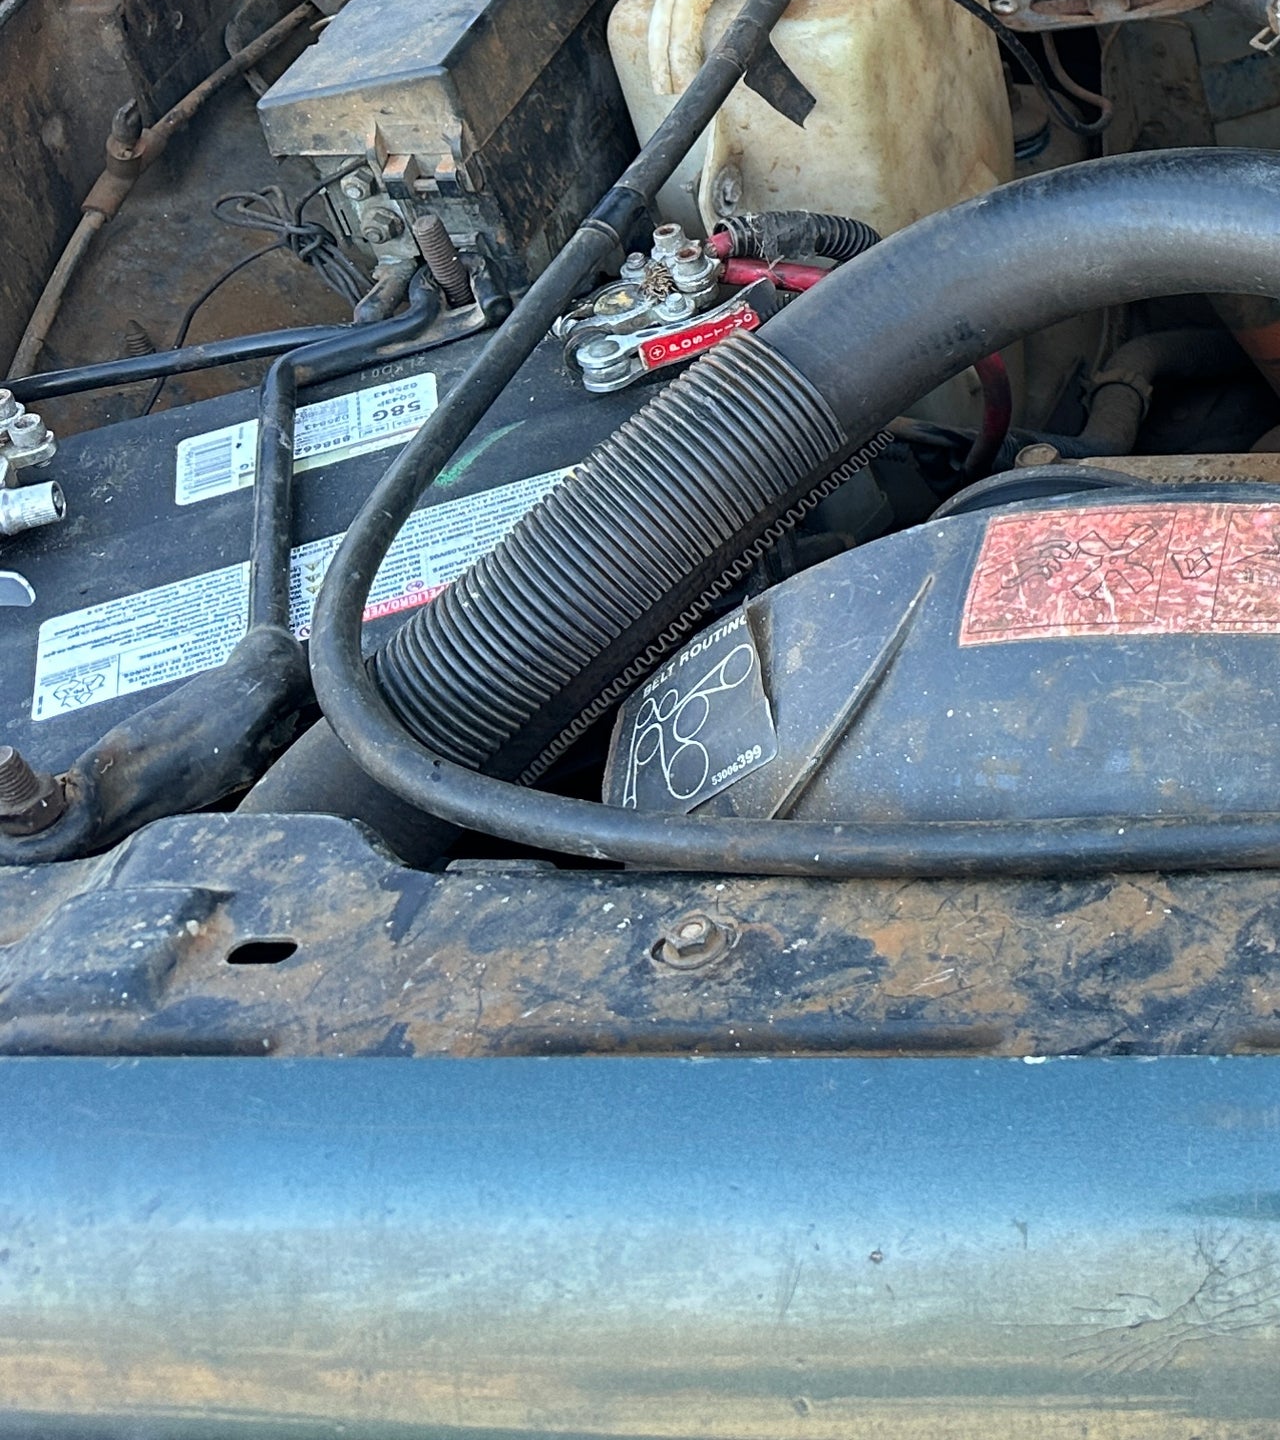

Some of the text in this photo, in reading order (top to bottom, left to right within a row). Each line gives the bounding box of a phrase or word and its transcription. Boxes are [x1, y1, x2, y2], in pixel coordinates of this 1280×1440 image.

[669, 313, 753, 352] POSITIVO
[372, 399, 421, 423] 58G
[643, 662, 676, 698] BELT
[711, 744, 762, 786] 53006399
